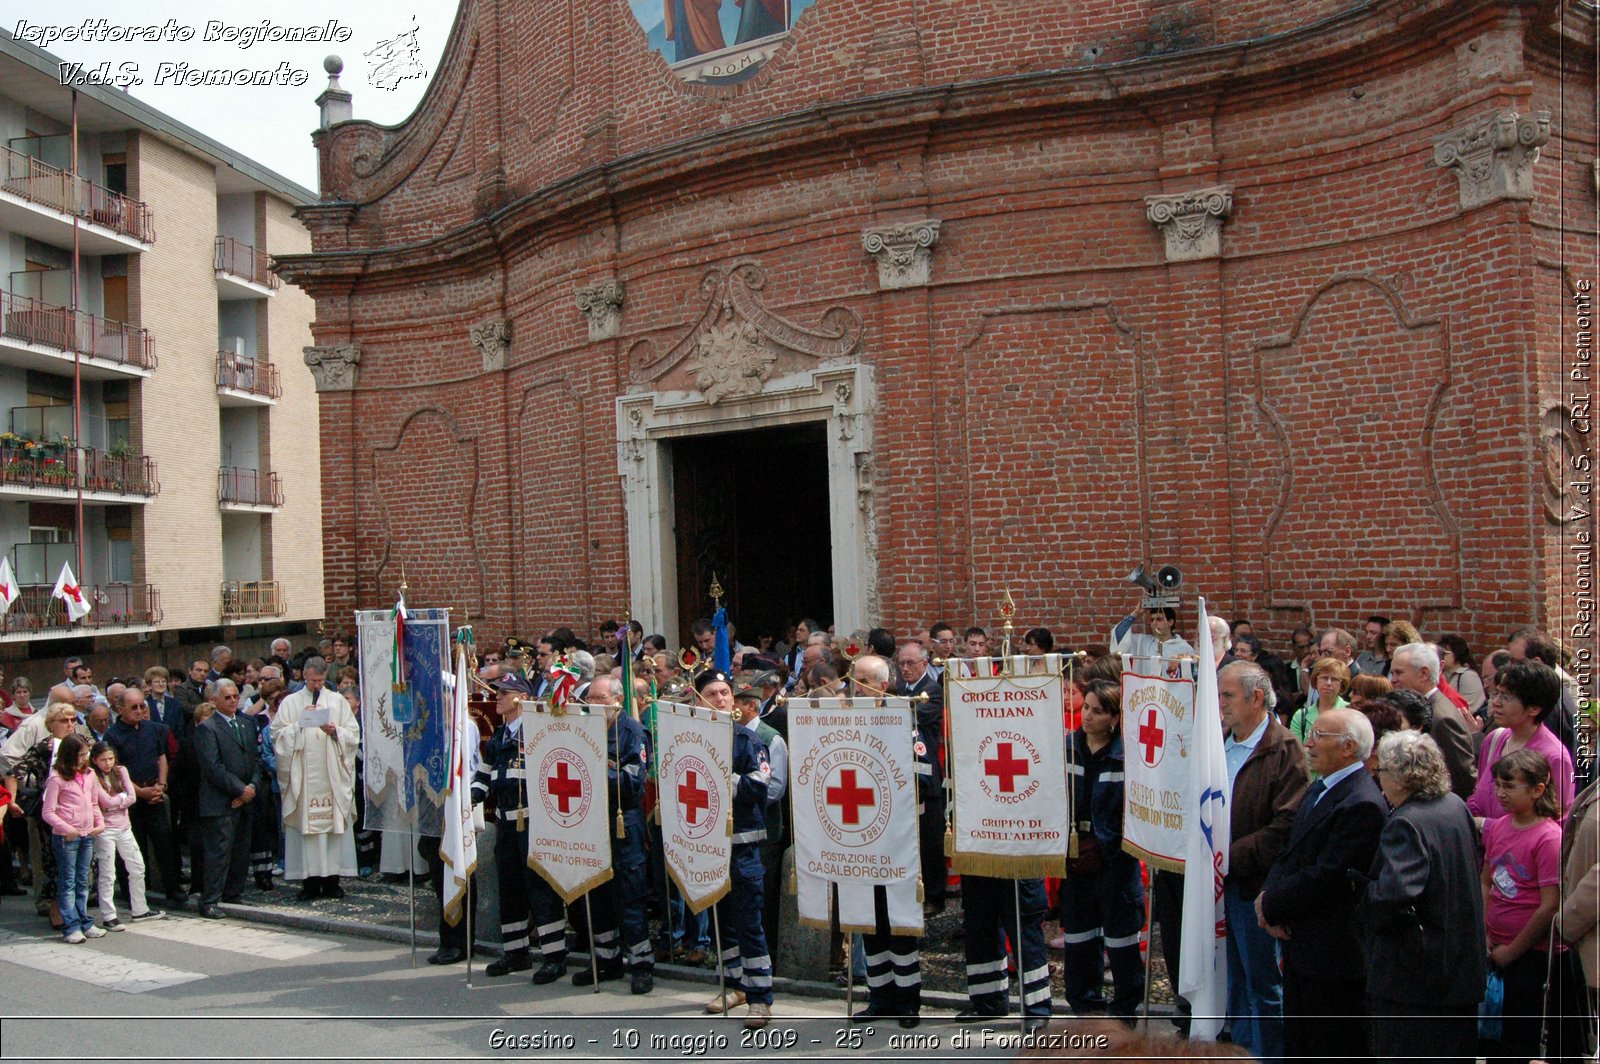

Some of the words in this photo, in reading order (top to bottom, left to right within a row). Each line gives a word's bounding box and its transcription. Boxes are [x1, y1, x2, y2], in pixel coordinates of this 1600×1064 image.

[711, 54, 756, 76] D.O.M.
[961, 691, 1001, 703] CROCE
[1004, 689, 1048, 702] ROSSA
[816, 716, 852, 726] VOLONTARI
[855, 716, 867, 726] DEL
[975, 706, 1034, 719] ITALIANA
[525, 728, 546, 756] CROCE
[547, 721, 572, 733] ROSSA
[574, 726, 603, 762] ITALIANA
[994, 730, 1041, 765] VOLONTARI
[660, 743, 676, 779] CROC
[674, 731, 703, 746] ROSSA
[703, 739, 732, 795] ITALIAN
[819, 730, 862, 749] ROSSA
[864, 733, 908, 791] ITALIANA
[821, 760, 832, 771] DI
[833, 751, 874, 771] GINEVRA
[874, 769, 887, 784] 22
[979, 779, 992, 798] DEL
[994, 779, 1040, 805] SOCCORSO
[814, 771, 843, 841] CONVENZIONE
[860, 822, 882, 842] 1864
[981, 818, 1025, 829] GRUPPO
[1029, 819, 1042, 829] DI
[568, 841, 597, 853] LOCALE
[695, 843, 726, 858] LOCALE
[532, 851, 564, 863] SETTMO
[820, 850, 877, 864] POSTAZIONE
[880, 856, 891, 865] DI
[689, 862, 729, 883] TORINES
[808, 861, 906, 879] CASALBORGONE
